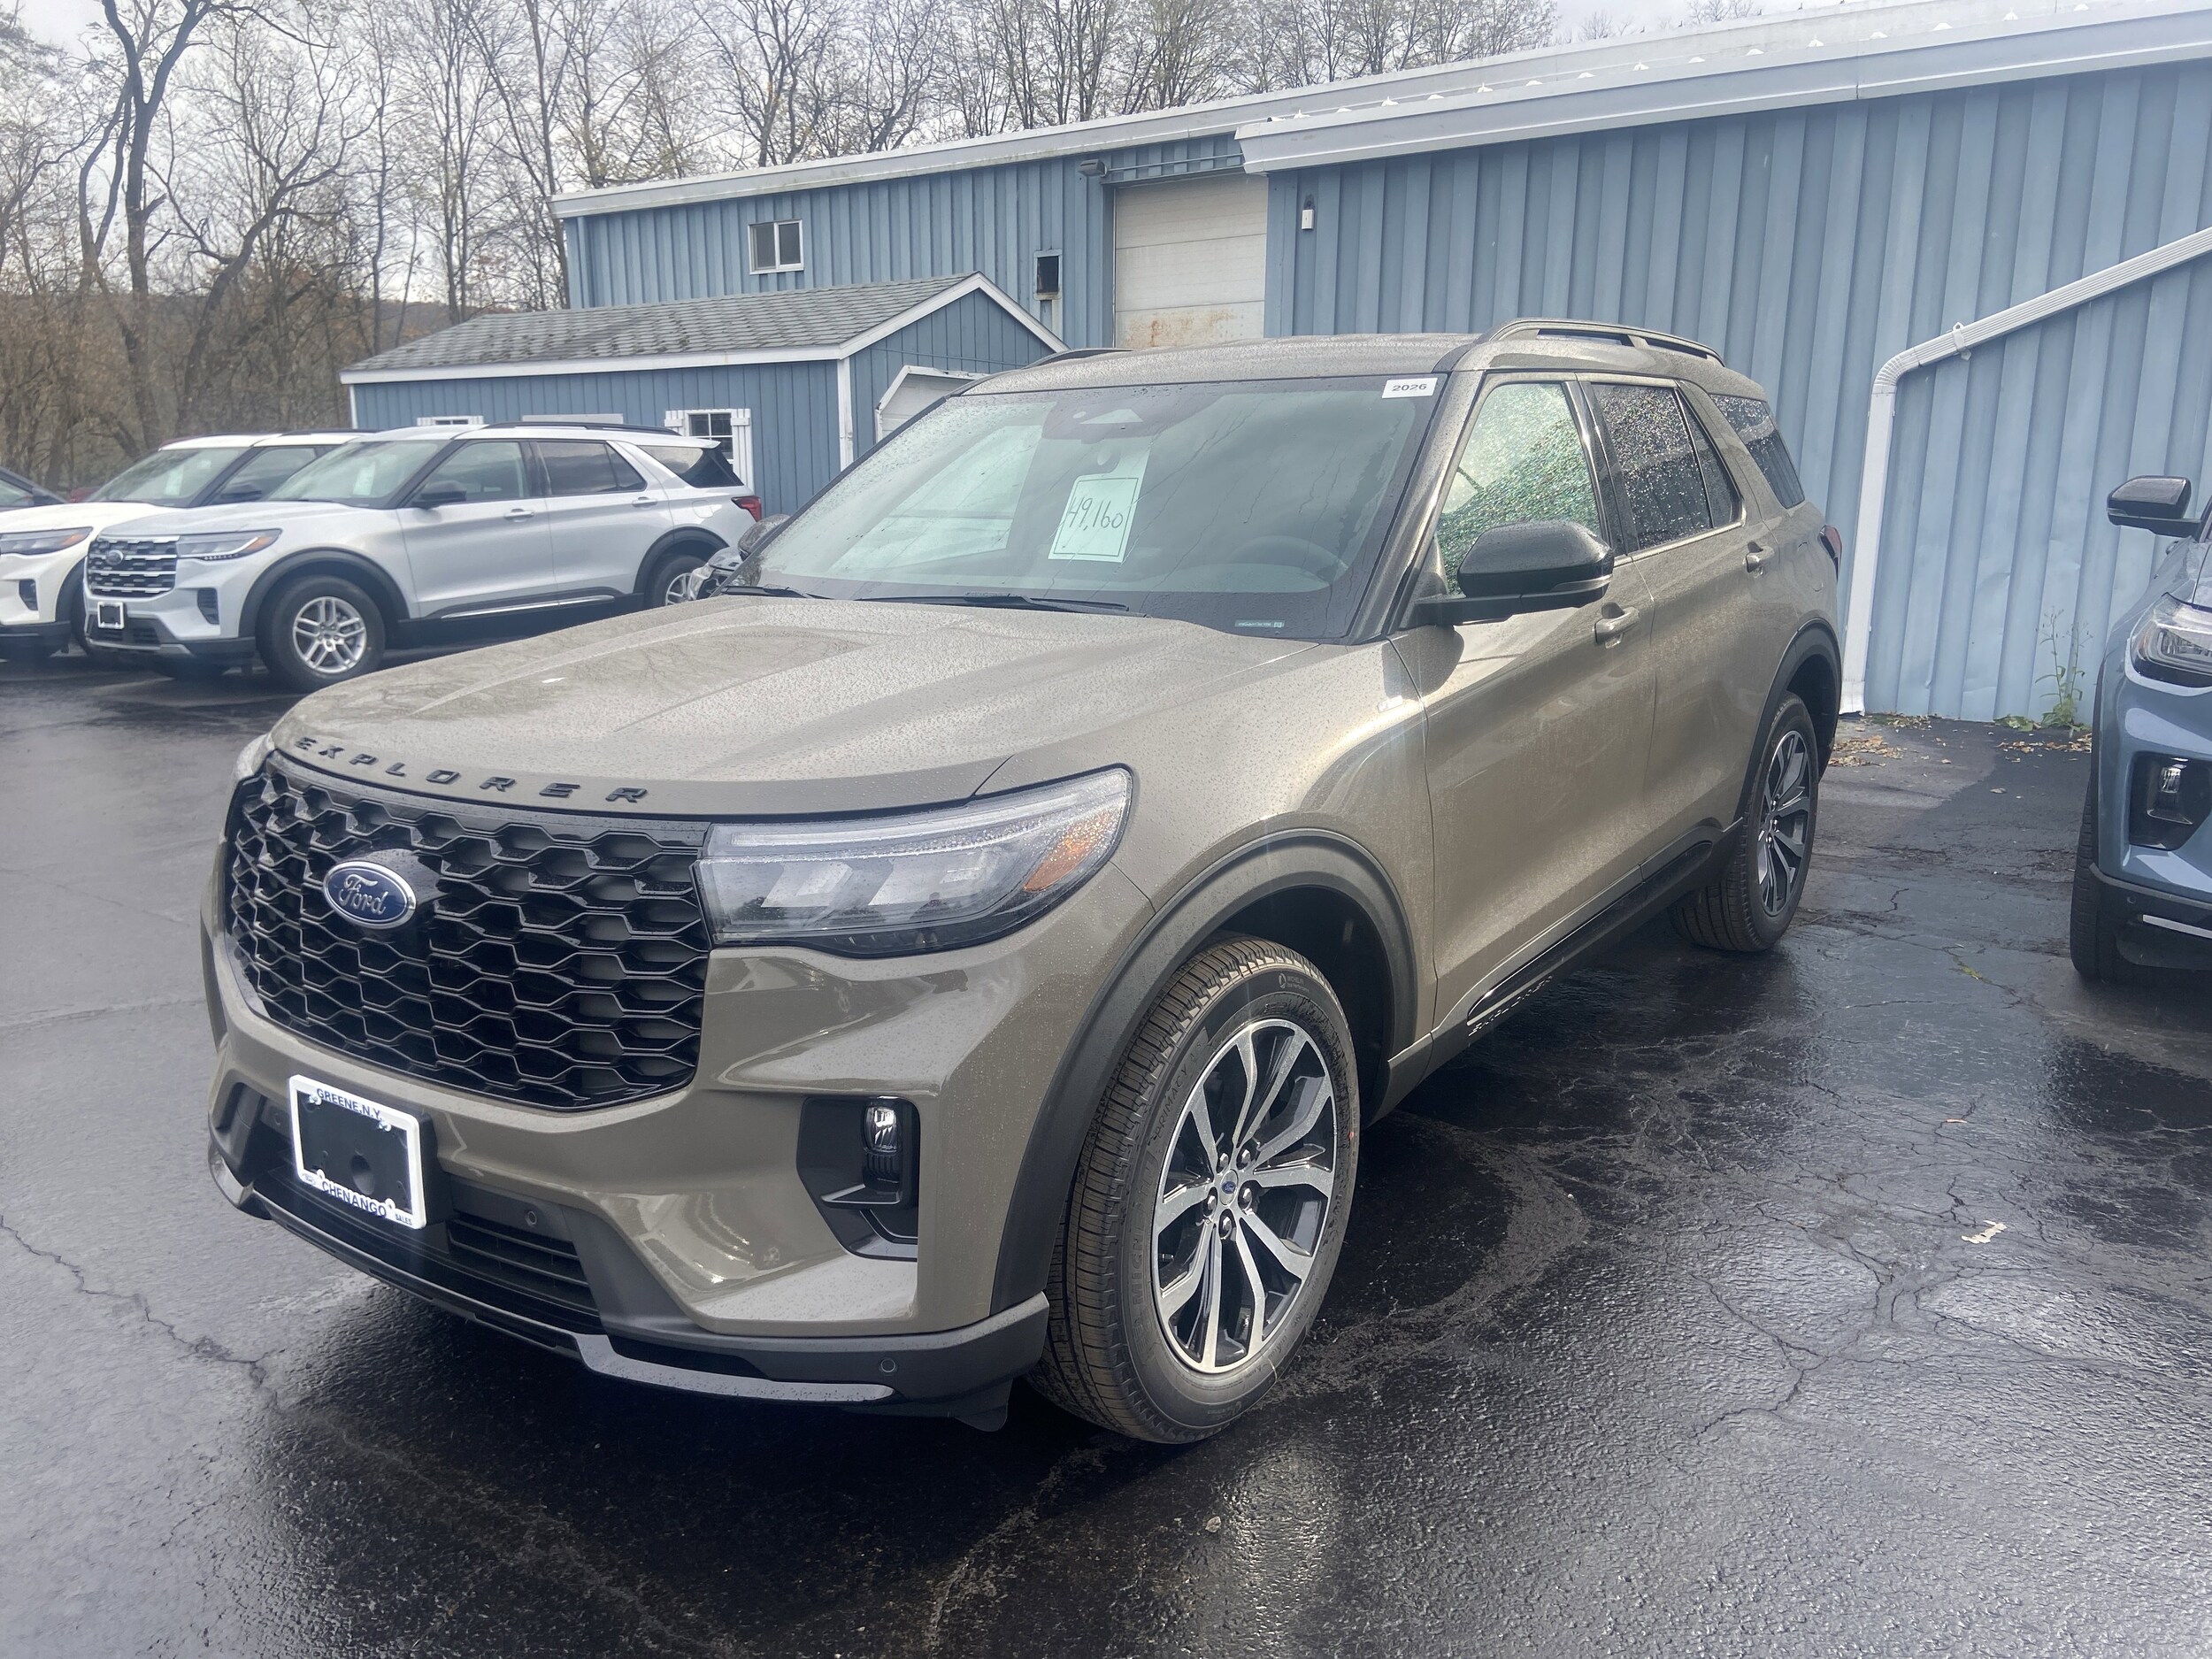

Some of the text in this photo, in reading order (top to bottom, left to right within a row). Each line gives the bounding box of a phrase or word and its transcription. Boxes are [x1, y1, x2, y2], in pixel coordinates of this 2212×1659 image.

[1068, 496, 1124, 531] 49,160
[294, 736, 648, 803] EXPLORER
[339, 873, 389, 915] Ford
[321, 1180, 387, 1217] CHENANGO
